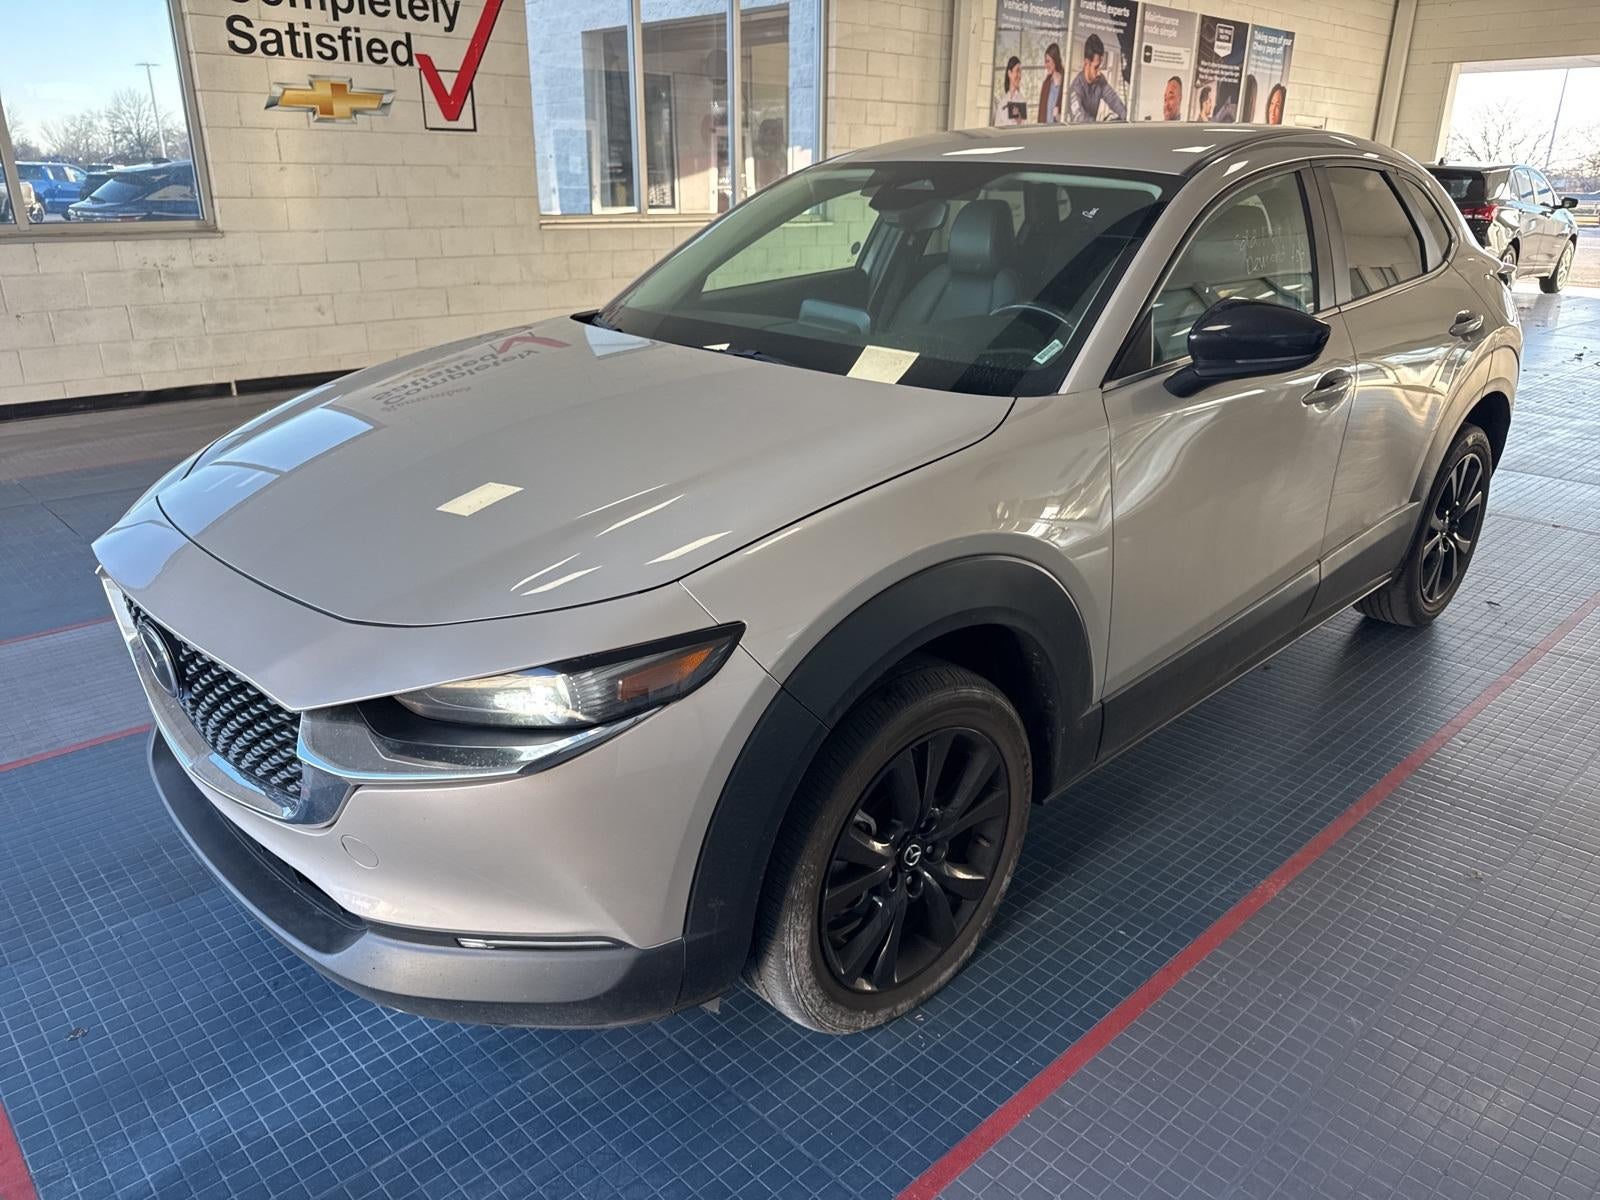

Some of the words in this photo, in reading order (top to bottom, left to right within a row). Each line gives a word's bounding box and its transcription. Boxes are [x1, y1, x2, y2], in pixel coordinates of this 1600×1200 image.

[231, 0, 460, 32] petely
[1029, 3, 1065, 18] Inspection
[1096, 1, 1107, 13] the
[1107, 5, 1130, 17] experts
[225, 14, 414, 67] Satisfied
